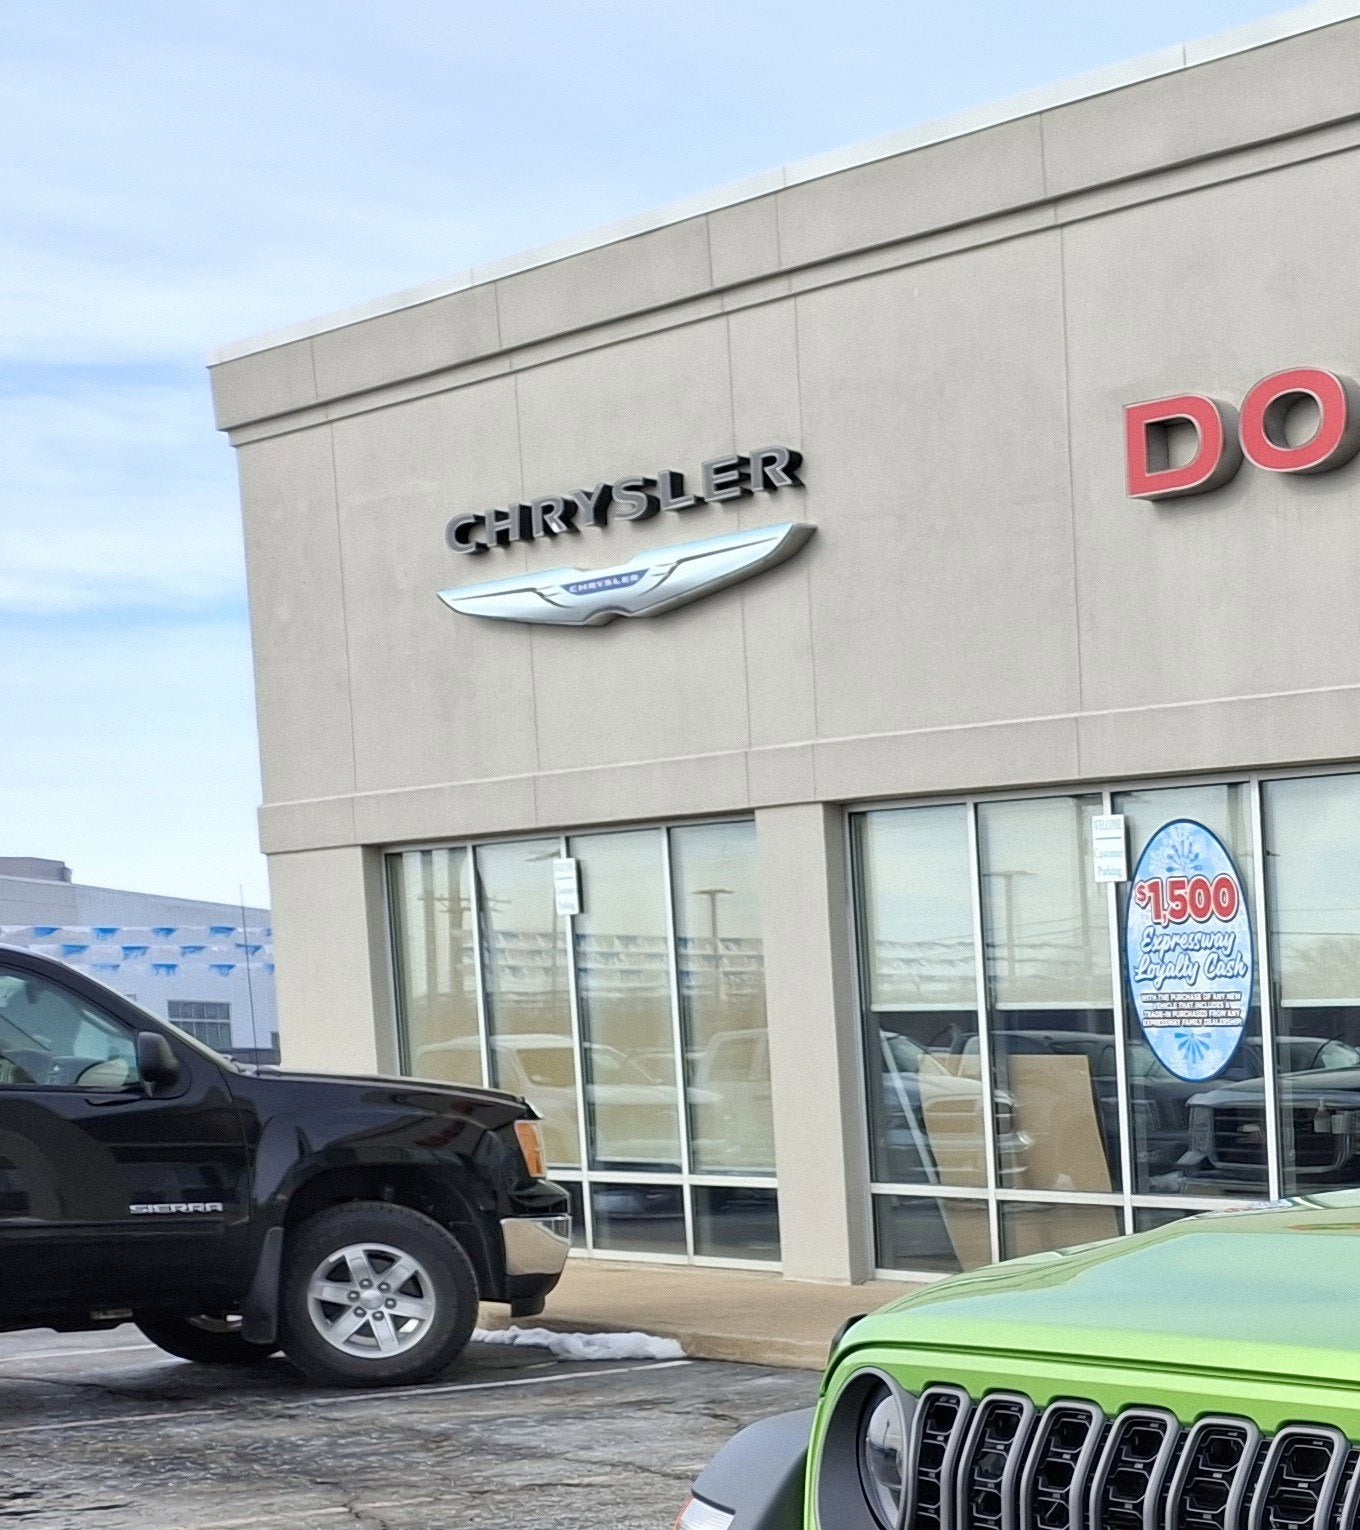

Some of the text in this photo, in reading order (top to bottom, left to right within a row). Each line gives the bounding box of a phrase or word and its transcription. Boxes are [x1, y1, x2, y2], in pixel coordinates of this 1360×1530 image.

[445, 444, 806, 555] CHRYSLER
[568, 574, 639, 593] CHRYSLER
[1134, 872, 1239, 927] $1,500
[1140, 925, 1236, 961] Expressway
[1133, 951, 1248, 991] Loyalty Cash
[129, 1202, 224, 1214] SIERRA
